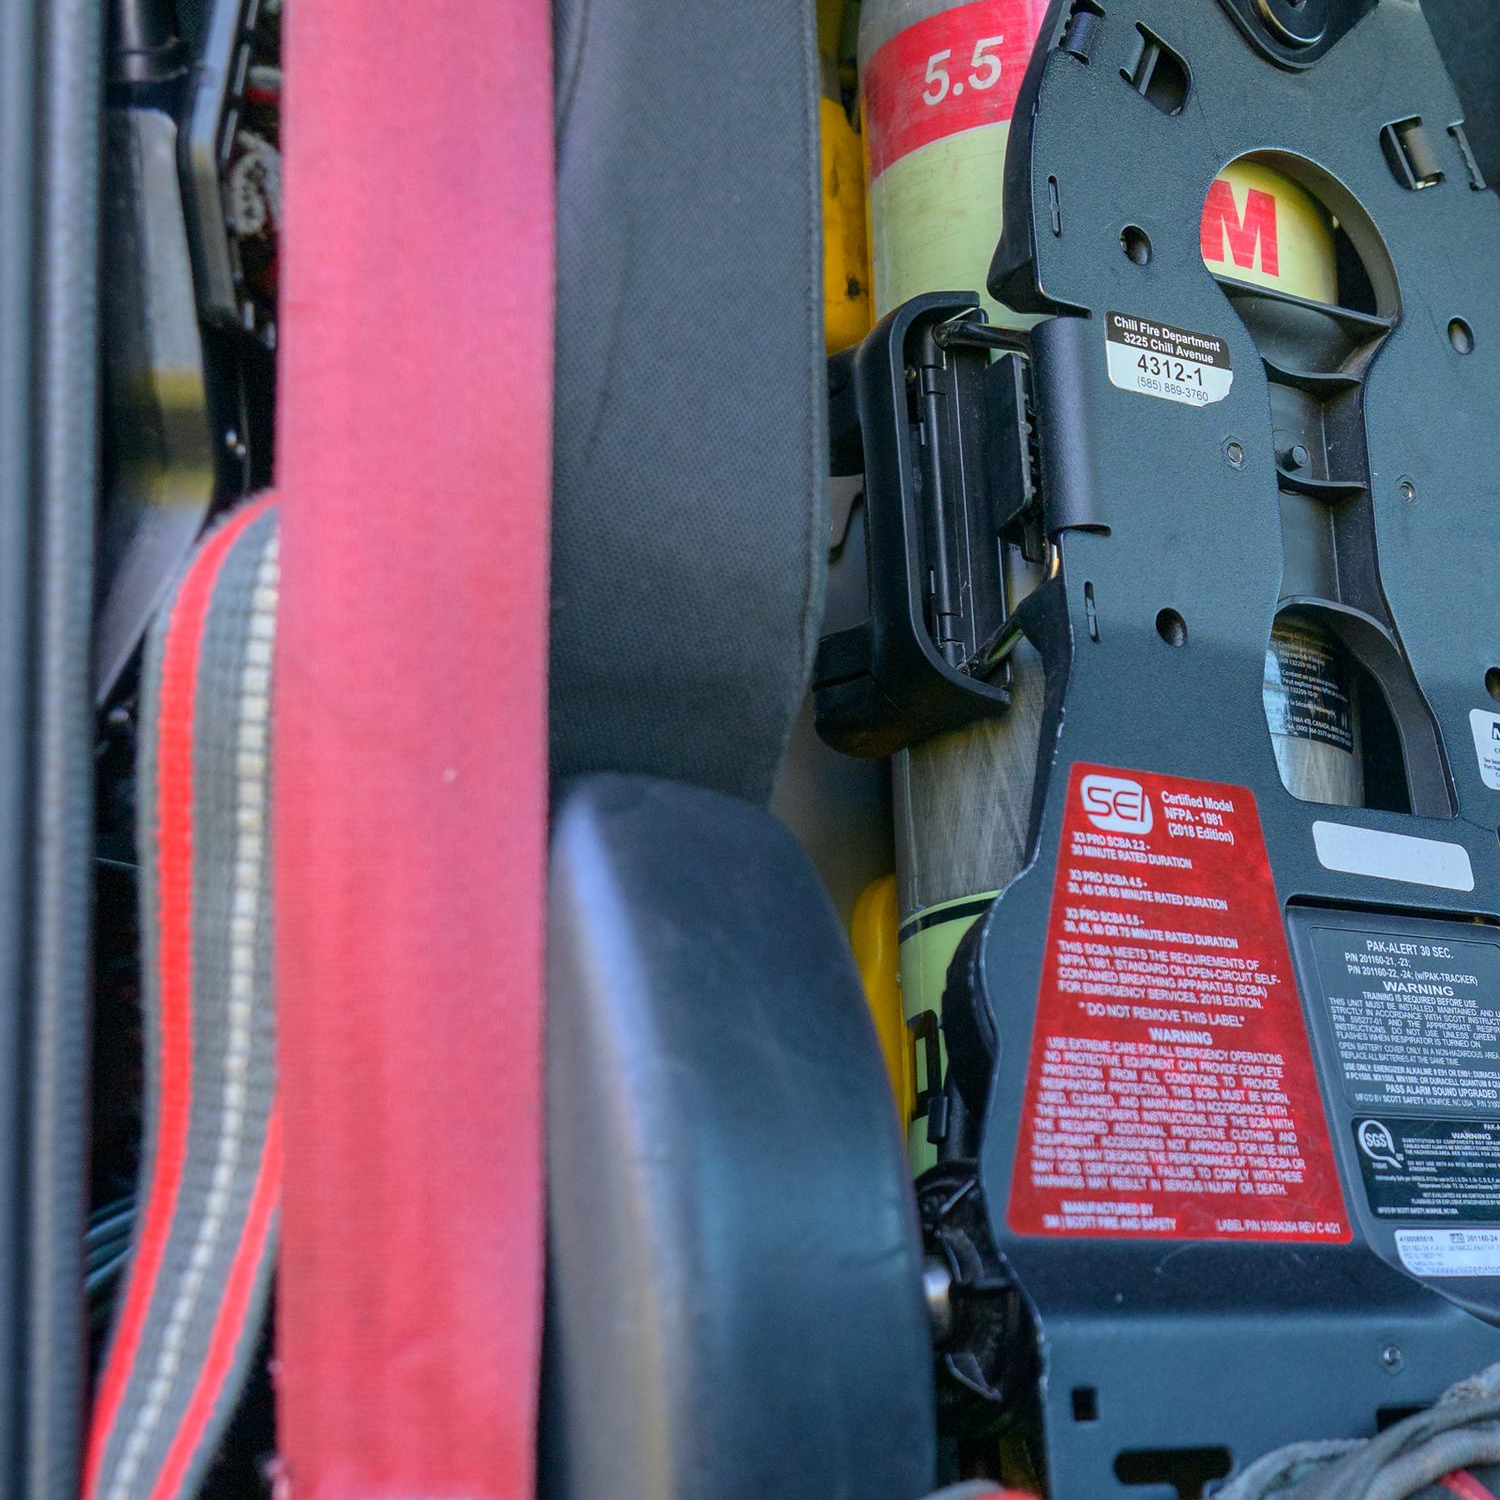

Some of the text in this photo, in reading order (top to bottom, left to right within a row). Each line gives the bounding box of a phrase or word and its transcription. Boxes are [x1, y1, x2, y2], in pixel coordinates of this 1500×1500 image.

[922, 36, 1003, 105] 5.5
[1114, 316, 1220, 351] Chili Fire Department
[1123, 332, 1213, 363] 3225 Chili Avenue
[1137, 354, 1202, 386] 4312-1
[1137, 376, 1209, 401] (585) 889-3760
[1086, 786, 1143, 823] SEI
[1161, 791, 1234, 812] Certified Model
[1164, 807, 1194, 821] NFPA
[1200, 811, 1223, 825] 1981
[1167, 823, 1234, 843] (2018 Edition)
[1071, 844, 1193, 868] 30 MINUTE RATED DURATION
[1057, 940, 1259, 970] THIS SCBA MEETS THE REQUIREMENTS OF
[1344, 953, 1359, 962] P/N
[1366, 940, 1454, 958] PAK-ALERT 30 SEC.
[1057, 954, 1088, 966] NFPA
[1347, 965, 1361, 974] P/N
[1057, 967, 1268, 997] CONTAINED BREATHING APPARATUS (SCBA)
[1383, 981, 1454, 995] WARNING
[1328, 997, 1346, 1005] THIS
[1365, 1000, 1385, 1008] MUST
[1480, 1009, 1494, 1017] AND
[1362, 992, 1395, 1001] TRAINING
[1394, 994, 1402, 1002] IS
[1402, 995, 1437, 1004] REQUIRED
[1436, 997, 1464, 1006] BEFORE
[1085, 1003, 1106, 1016] DO
[1106, 1004, 1131, 1018] NOT
[1131, 1007, 1181, 1022] REMOVE
[1180, 1011, 1208, 1024] THIS
[1330, 1006, 1363, 1016] STRICTLY
[1365, 1009, 1374, 1017] IN
[1375, 1009, 1423, 1019] ACCORDANCE
[1423, 1013, 1442, 1021] WITH
[1443, 1014, 1466, 1022] SCOTT
[1391, 1027, 1403, 1036] DO
[1406, 1028, 1420, 1037] NOT
[1424, 1029, 1439, 1038] USE
[1442, 1030, 1470, 1039] UNLESS
[1473, 1032, 1497, 1041] GREEN
[1426, 1021, 1472, 1031] APPROPRIATE
[1148, 1028, 1213, 1044] WARNING
[1336, 1032, 1369, 1041] FLASHES
[1368, 1034, 1391, 1042] WHEN
[1390, 1035, 1434, 1044] RESPIRATOR
[1441, 1039, 1470, 1047] TURNED
[1385, 1084, 1498, 1098] PASS ALARM SOUND UPGRADED
[1365, 1133, 1387, 1148] SGS
[1451, 1132, 1492, 1140] WARNING
